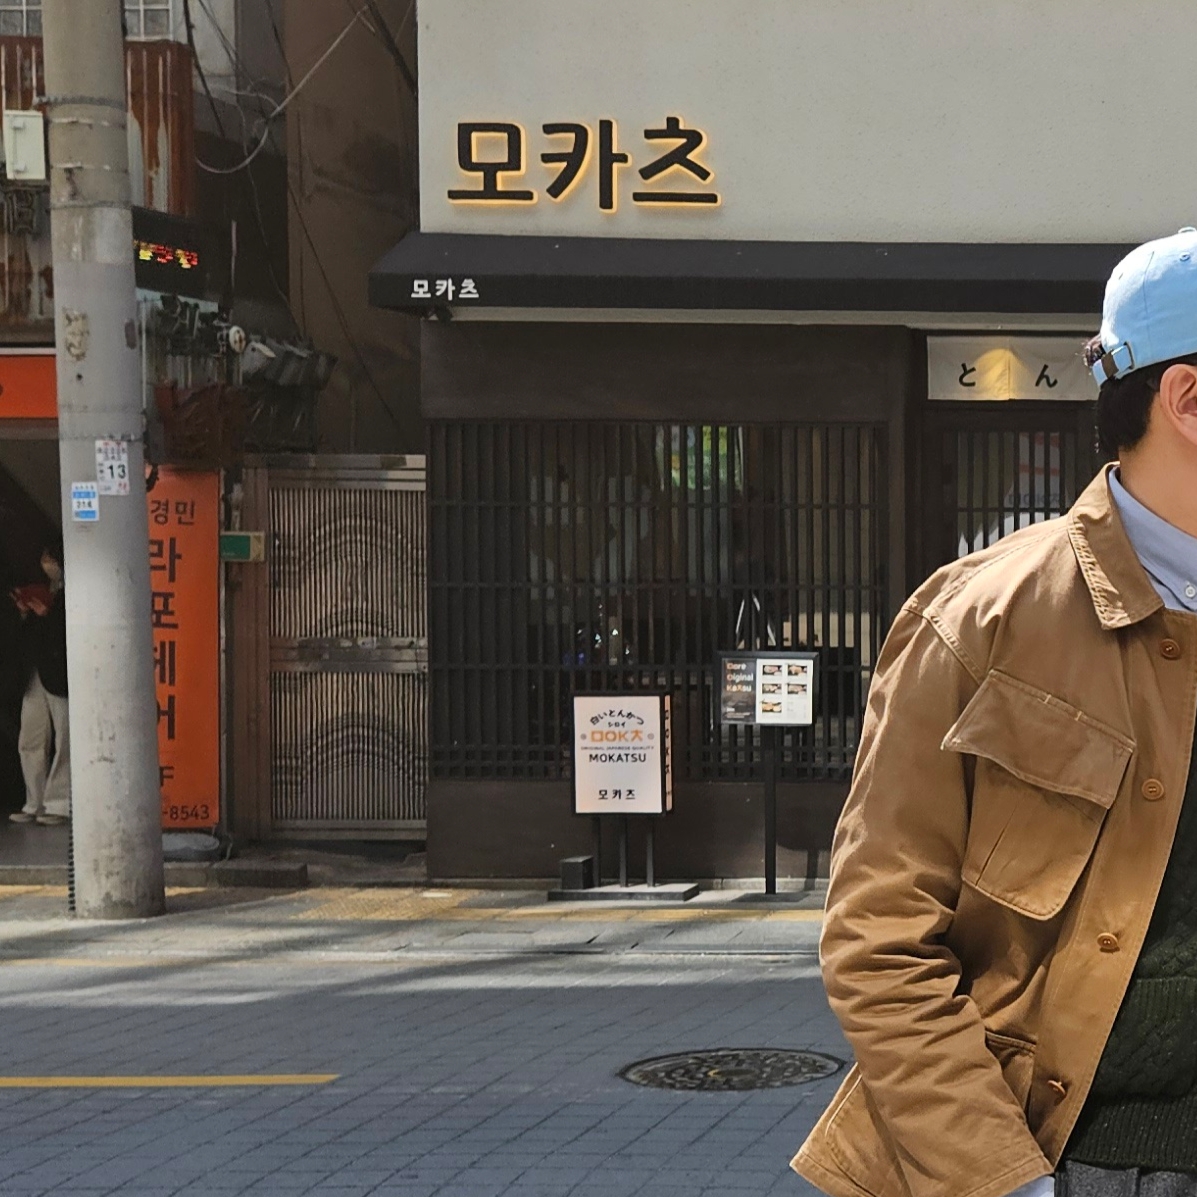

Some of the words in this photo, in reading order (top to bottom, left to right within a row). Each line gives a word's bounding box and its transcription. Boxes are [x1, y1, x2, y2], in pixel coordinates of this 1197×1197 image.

[447, 116, 719, 210] 모카츠
[411, 278, 480, 300] 모카츠
[107, 464, 126, 479] 13
[588, 753, 647, 763] MOKATSU
